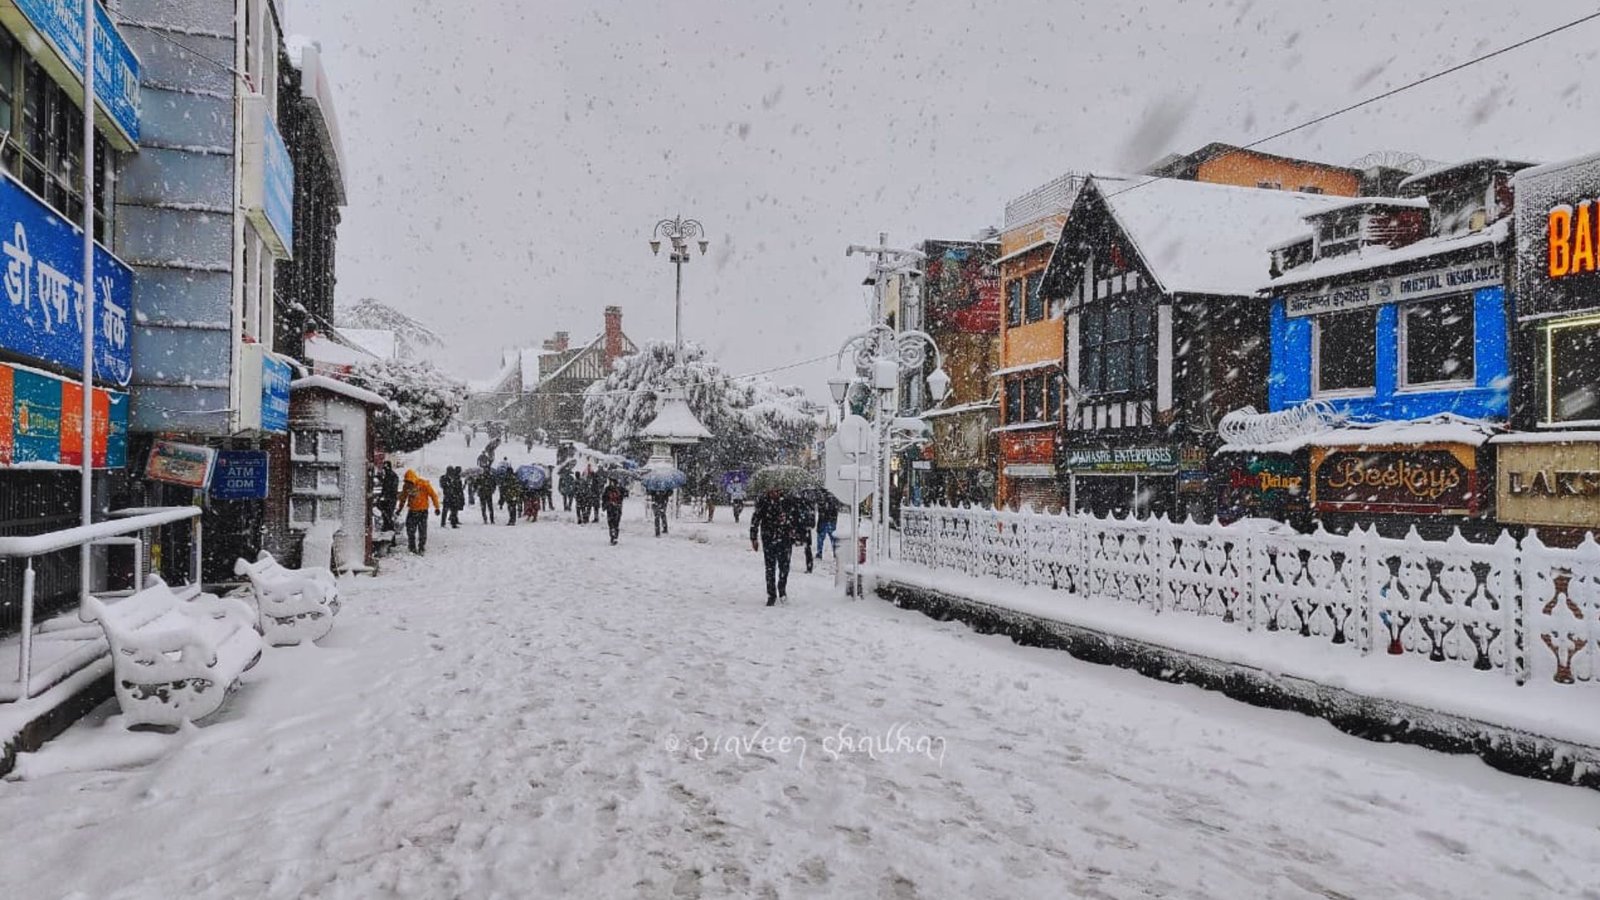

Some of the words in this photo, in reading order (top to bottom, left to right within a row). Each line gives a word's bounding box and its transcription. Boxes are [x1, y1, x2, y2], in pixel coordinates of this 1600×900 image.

[1548, 200, 1600, 278] BA
[1446, 264, 1501, 286] INSURANCE
[1114, 447, 1172, 464] ENTERPRISES
[228, 467, 254, 477] ATM
